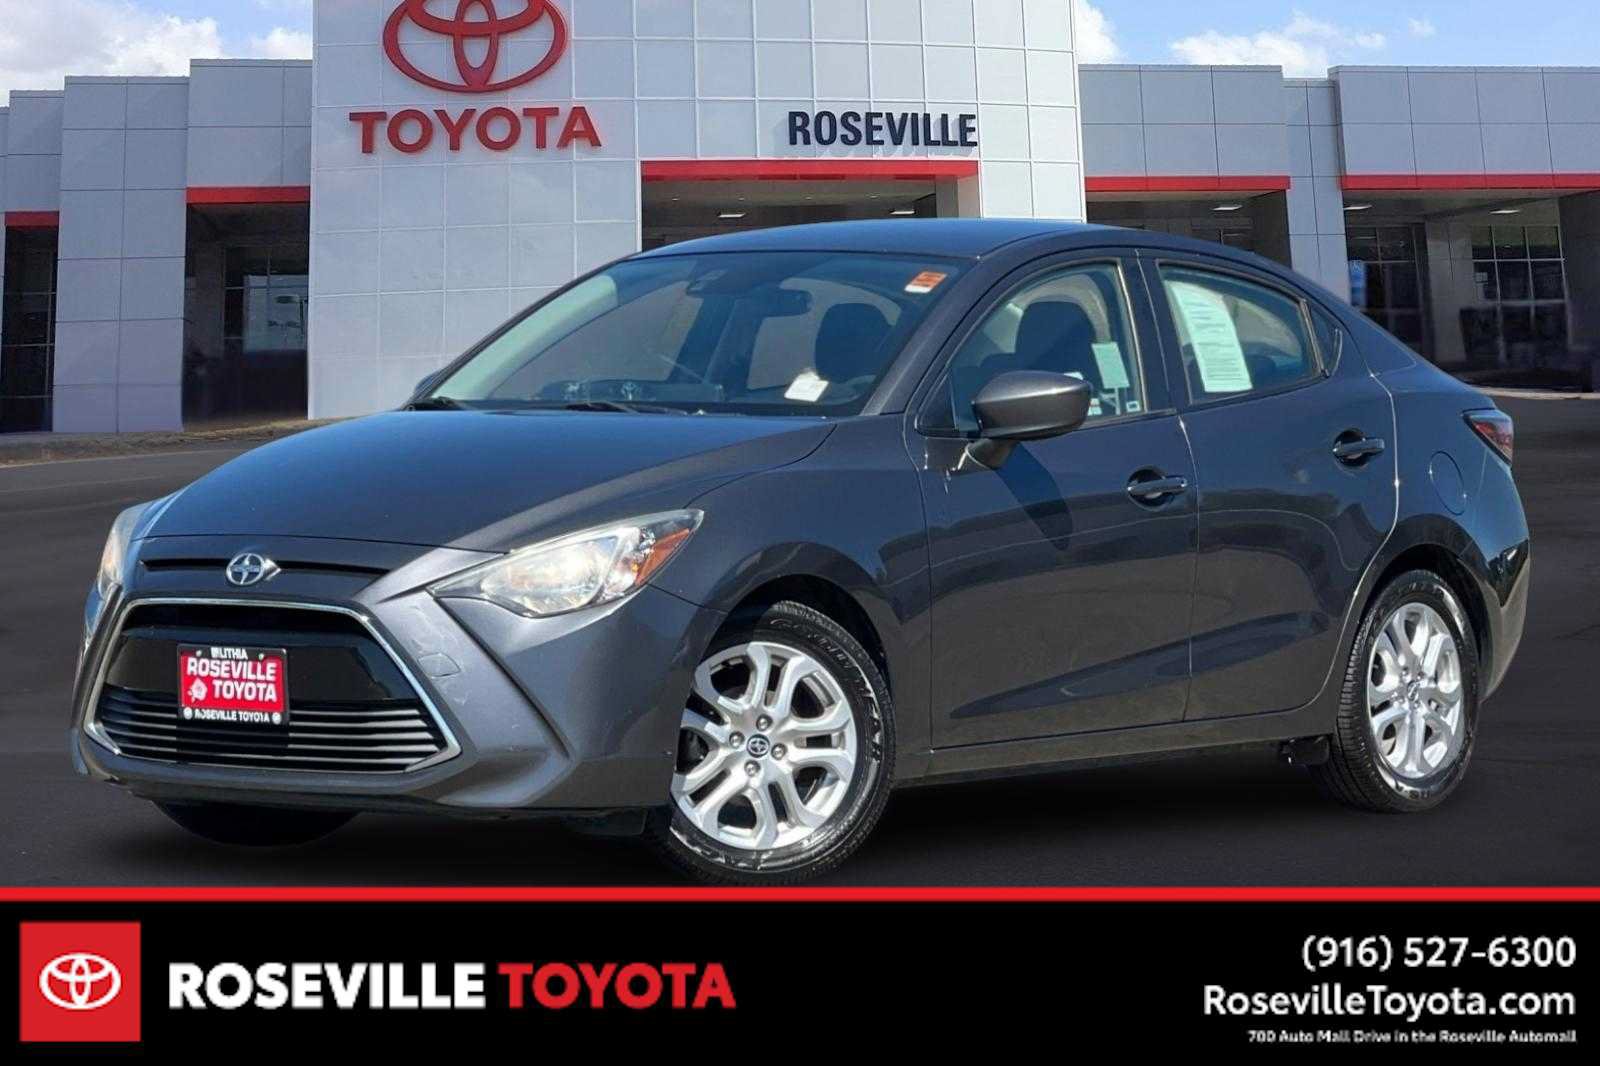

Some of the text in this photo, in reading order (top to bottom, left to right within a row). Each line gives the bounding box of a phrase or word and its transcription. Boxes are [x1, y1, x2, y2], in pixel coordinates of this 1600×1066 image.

[350, 105, 602, 153] TOYOTA
[788, 110, 978, 148] ROSEVILLE
[186, 657, 277, 681] ROSEVILLE
[212, 680, 278, 702] TOYOTA
[194, 708, 270, 723] ROSEVILLE TOYOTA
